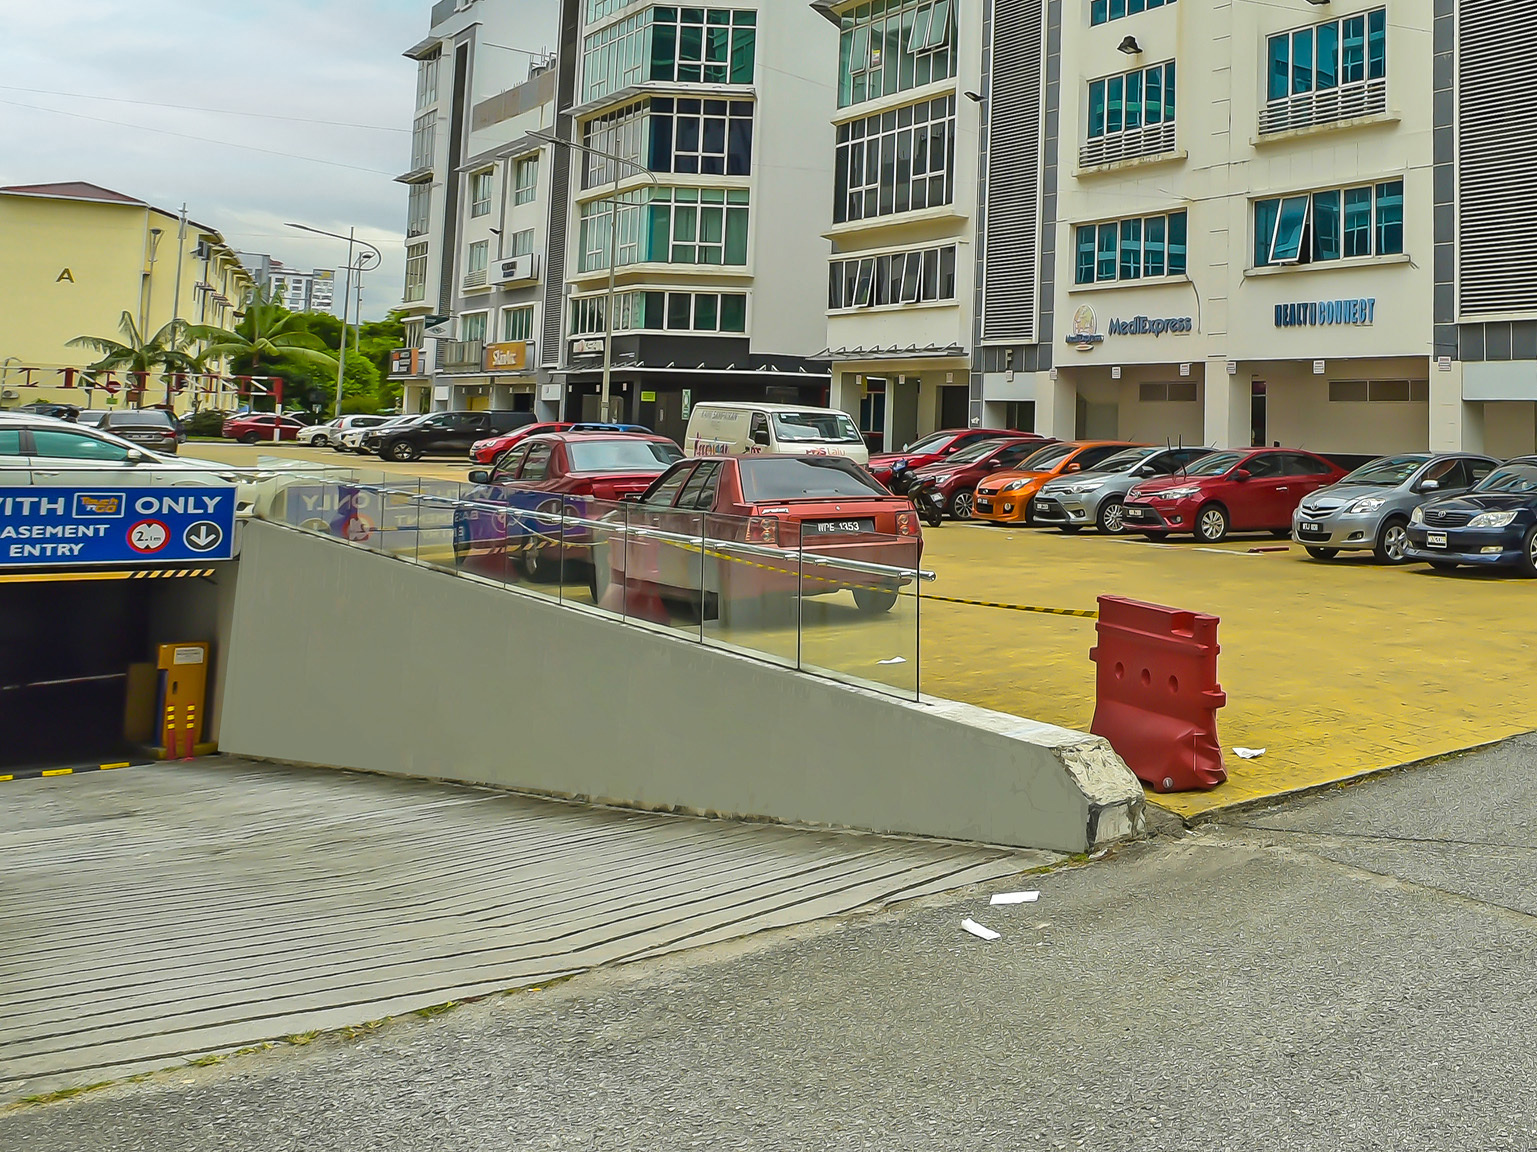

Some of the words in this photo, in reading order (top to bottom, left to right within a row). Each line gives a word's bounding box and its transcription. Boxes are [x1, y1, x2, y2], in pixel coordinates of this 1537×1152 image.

[56, 267, 75, 284] A
[0, 497, 65, 516] ITH
[134, 496, 222, 515] ONLY
[0, 525, 111, 539] ASEMENT
[9, 543, 85, 557] ENTRY
